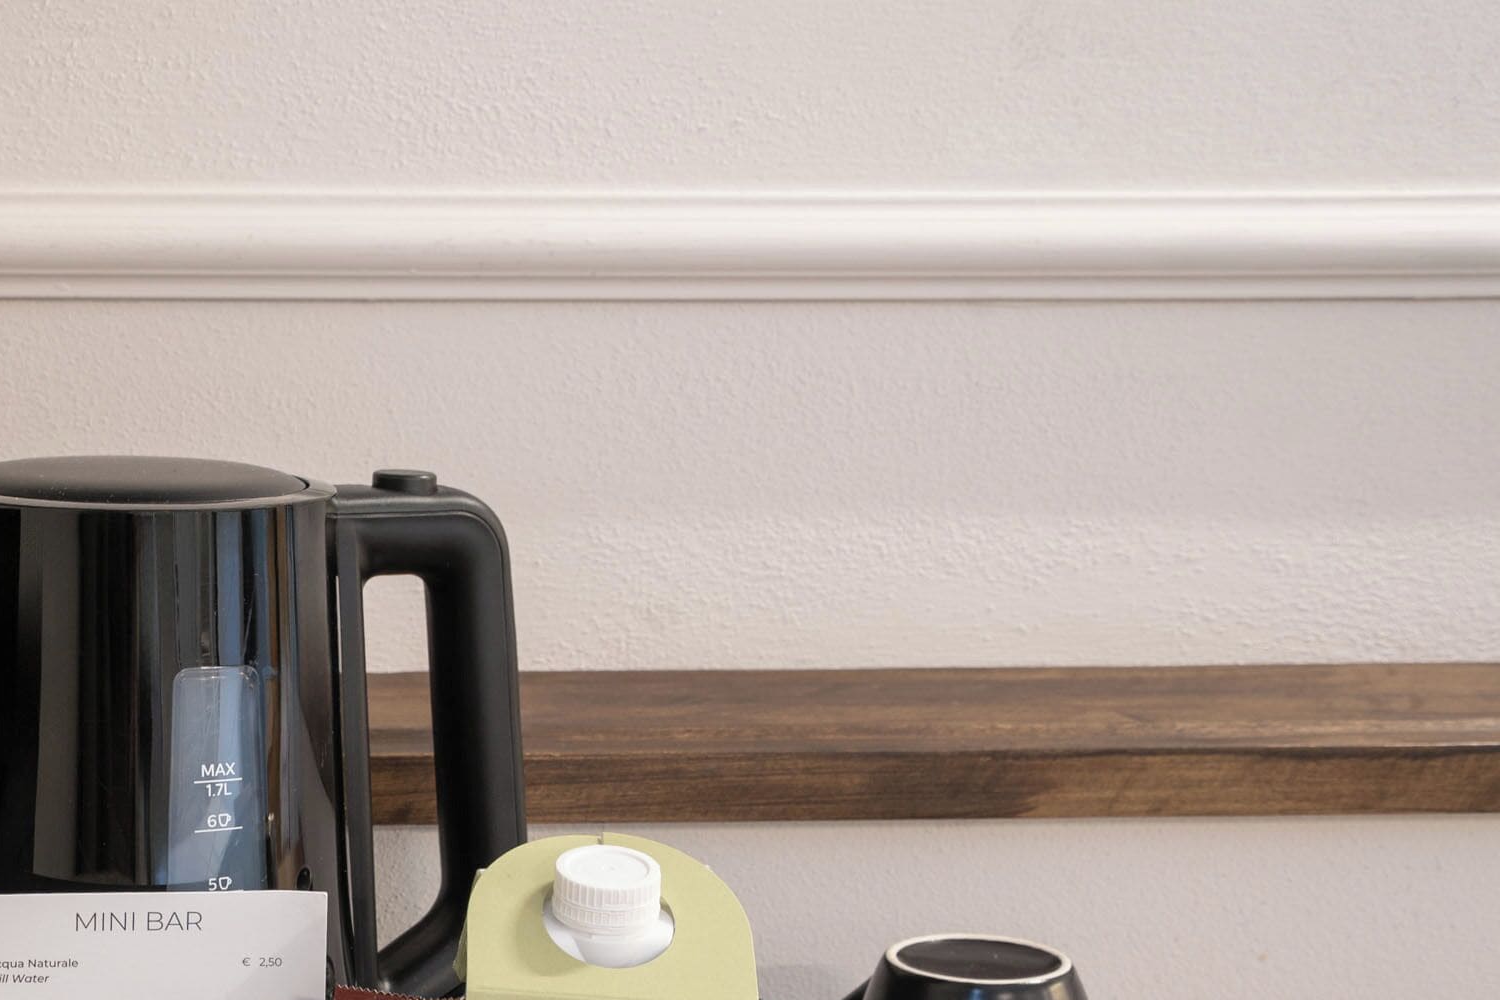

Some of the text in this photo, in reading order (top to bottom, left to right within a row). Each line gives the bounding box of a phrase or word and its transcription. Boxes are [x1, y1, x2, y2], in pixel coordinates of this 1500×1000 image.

[201, 762, 235, 777] MAX
[206, 783, 232, 797] 1.7L
[207, 815, 217, 828] 6
[75, 911, 203, 932] MINI BAR
[27, 957, 79, 968] Naturale
[242, 956, 282, 968] € 2,50
[12, 973, 50, 984] Water
